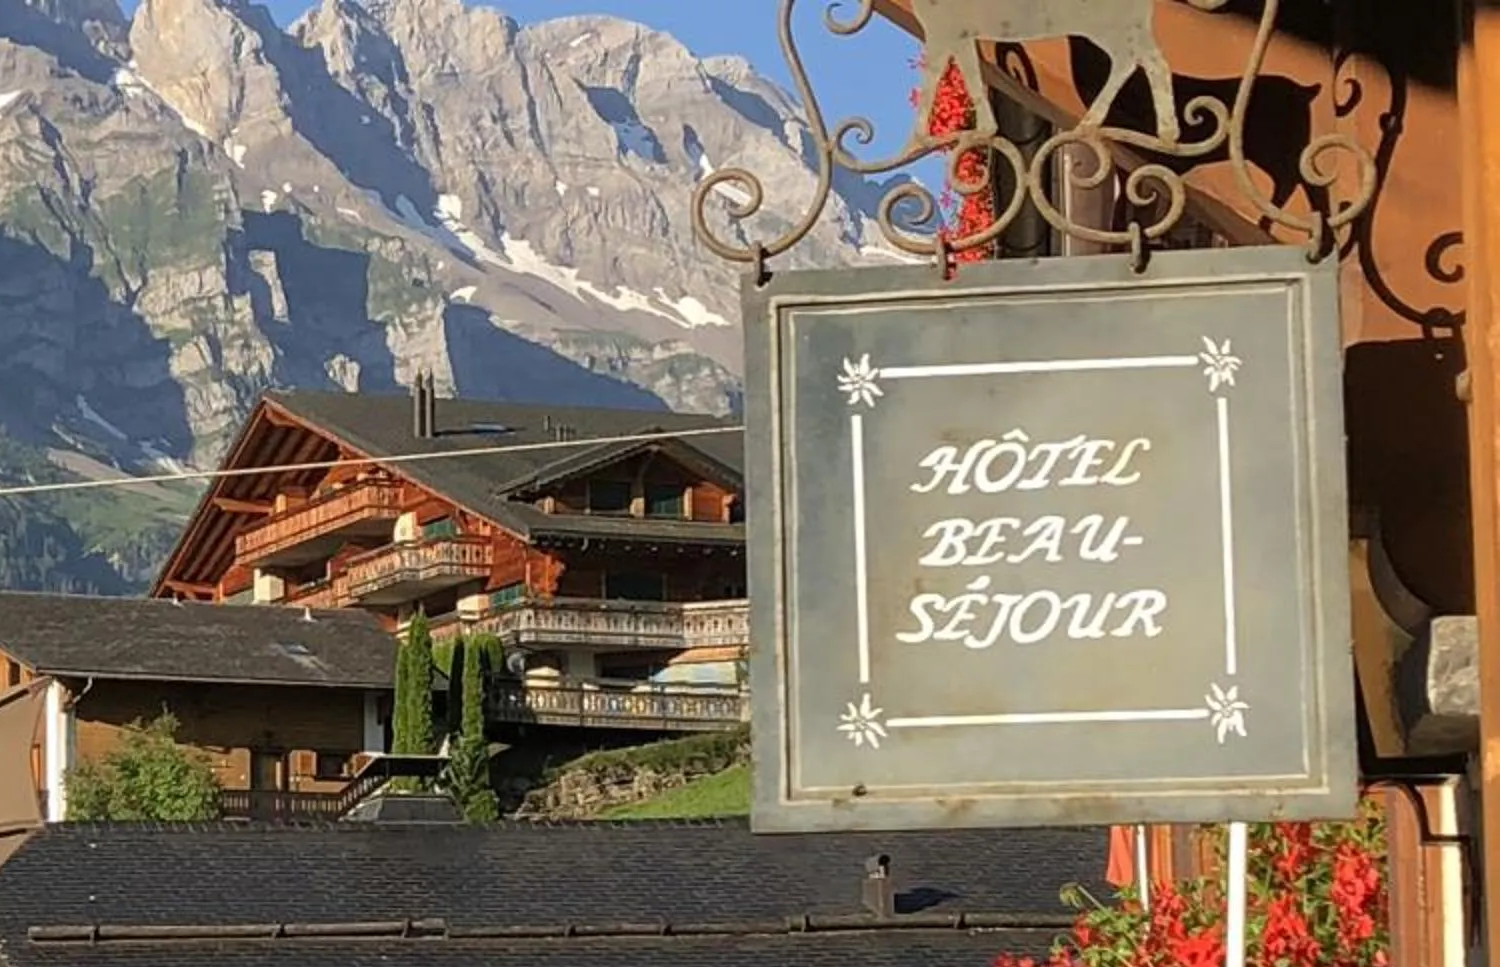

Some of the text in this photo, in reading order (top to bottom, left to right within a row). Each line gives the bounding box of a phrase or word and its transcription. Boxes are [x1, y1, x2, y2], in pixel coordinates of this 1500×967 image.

[910, 428, 1151, 495] HÔTEL
[918, 514, 1143, 566] BEAU-
[895, 575, 1167, 649] SÉJOUR
